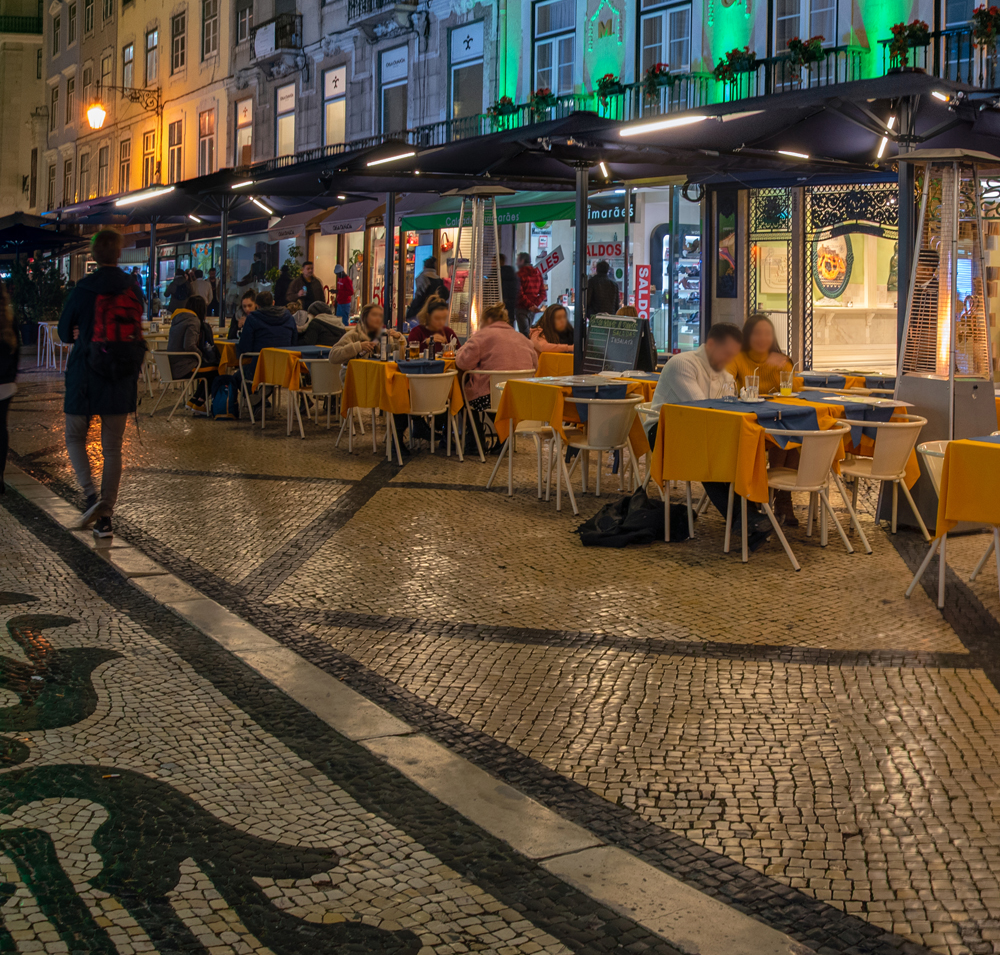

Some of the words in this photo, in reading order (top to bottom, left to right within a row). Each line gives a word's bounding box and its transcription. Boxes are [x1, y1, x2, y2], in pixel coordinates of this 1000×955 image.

[484, 212, 520, 224] uiarães
[587, 207, 634, 220] imarães
[586, 243, 622, 257] ALDOS
[538, 251, 560, 274] LES
[638, 267, 650, 320] SALDO
